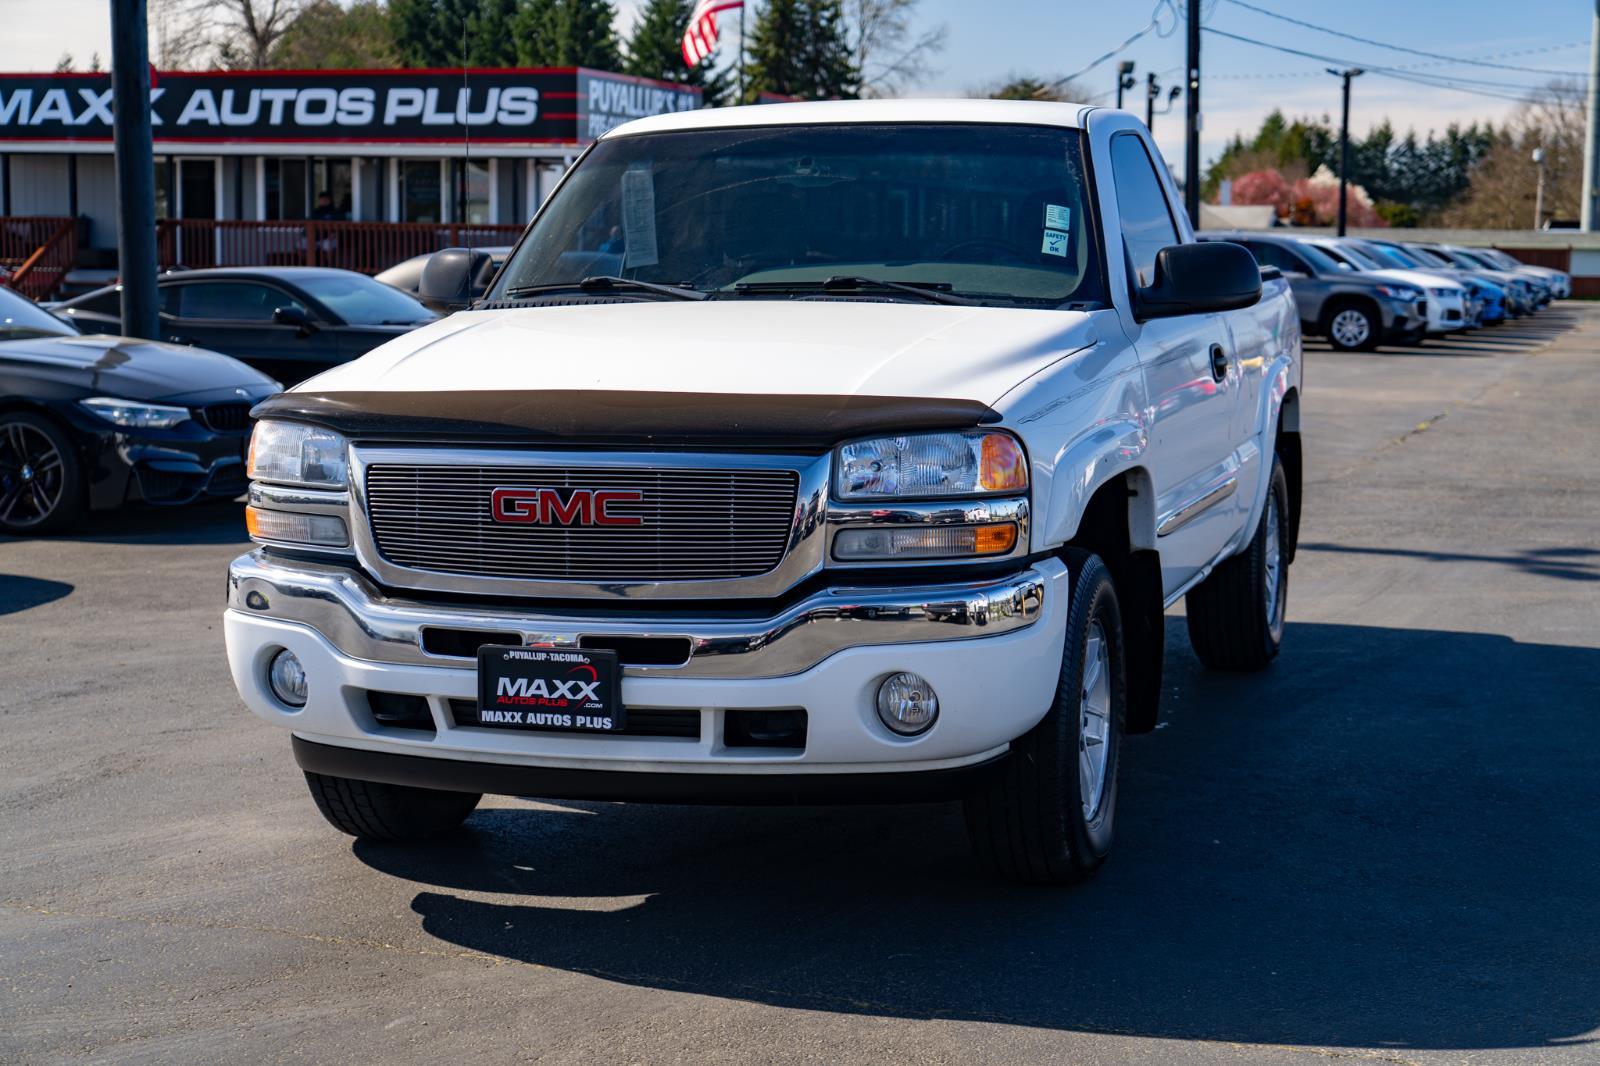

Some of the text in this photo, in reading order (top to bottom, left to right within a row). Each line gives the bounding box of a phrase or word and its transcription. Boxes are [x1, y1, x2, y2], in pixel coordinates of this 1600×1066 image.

[176, 87, 376, 126] AUTOS
[383, 87, 539, 126] PLUS
[1046, 232, 1066, 240] SAFETY
[491, 487, 643, 526] GMC
[497, 677, 600, 700] MAXX
[496, 696, 569, 707] AUTOS PLUS
[481, 710, 612, 729] MAXX AUTOS PLUS
